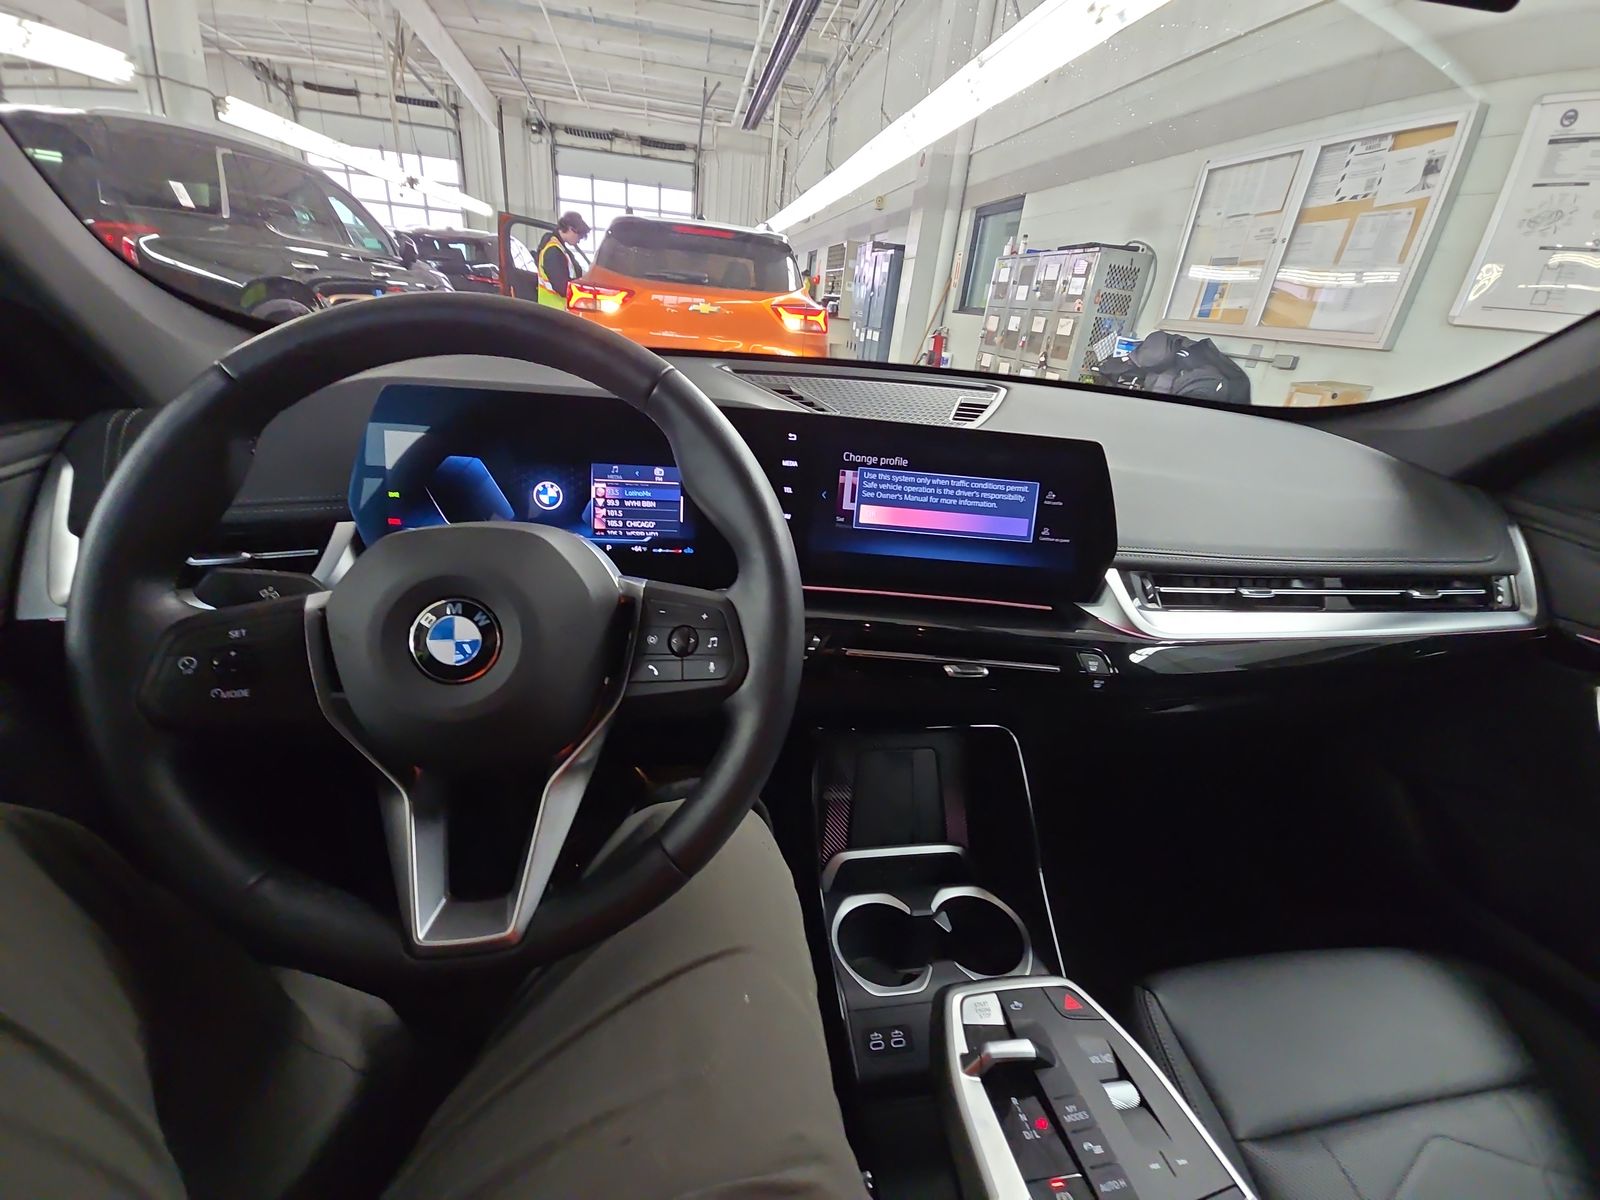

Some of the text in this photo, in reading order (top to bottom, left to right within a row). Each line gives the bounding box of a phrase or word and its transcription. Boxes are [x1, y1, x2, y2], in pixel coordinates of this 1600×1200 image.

[782, 459, 798, 467] MEDIA
[843, 451, 908, 466] Change profile
[863, 471, 1029, 493] Use this system only when traffic conditions permit.
[862, 480, 1026, 503] Safe vehicle operation is the driver's responsibility.
[606, 499, 620, 507] 99.9
[862, 490, 875, 498] See
[876, 491, 902, 500] Owner's
[904, 494, 928, 503] Manual
[958, 499, 998, 509] information.
[607, 509, 623, 517] 101.5
[420, 603, 491, 628] BMW
[228, 628, 247, 639] SET
[222, 688, 249, 699] MODE
[1010, 1096, 1019, 1106] R
[1064, 1104, 1078, 1113] MY
[1018, 1113, 1028, 1122] N
[1063, 1110, 1090, 1123] MODES
[1022, 1129, 1041, 1140] D/L
[1099, 1178, 1128, 1193] AUTO H
